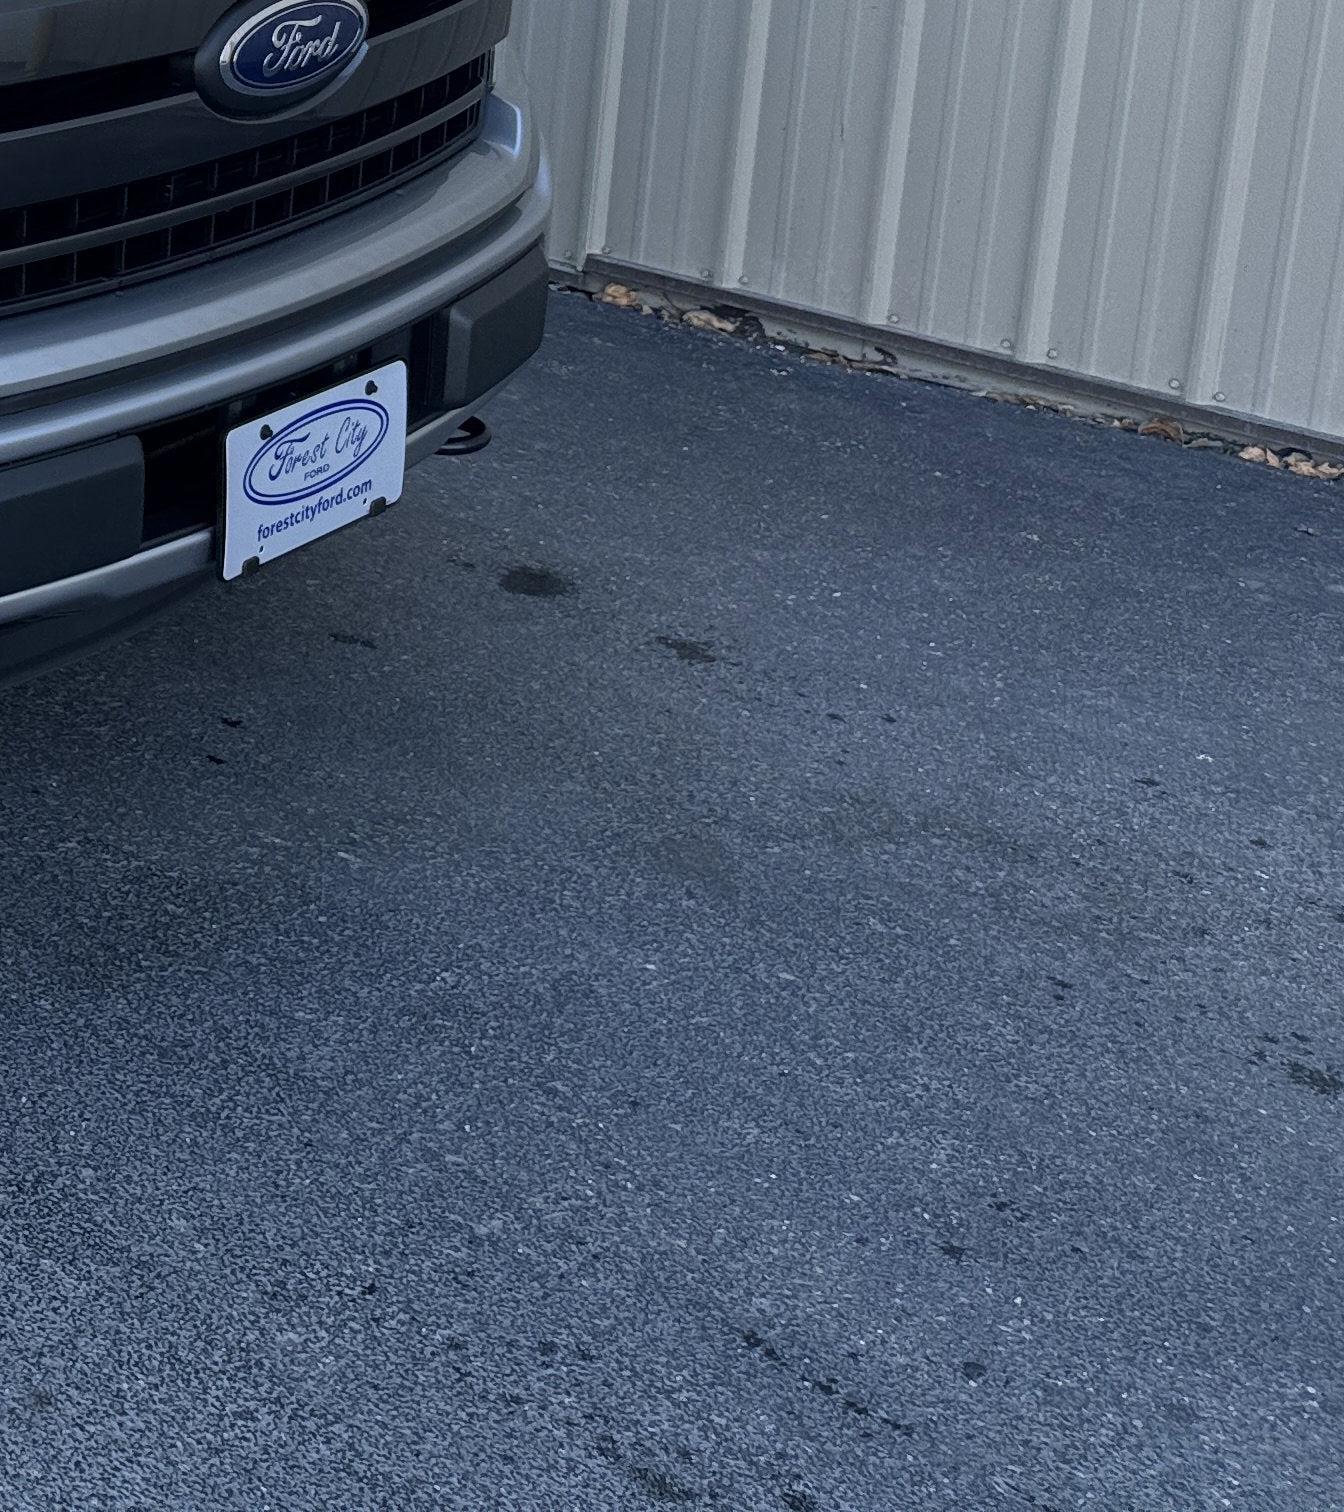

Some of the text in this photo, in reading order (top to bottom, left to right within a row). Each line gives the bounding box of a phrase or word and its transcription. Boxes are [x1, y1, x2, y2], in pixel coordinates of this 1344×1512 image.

[263, 14, 342, 77] Ford
[268, 416, 368, 481] Forest City
[303, 463, 331, 482] FORD
[257, 479, 373, 542] forestcityford.com
